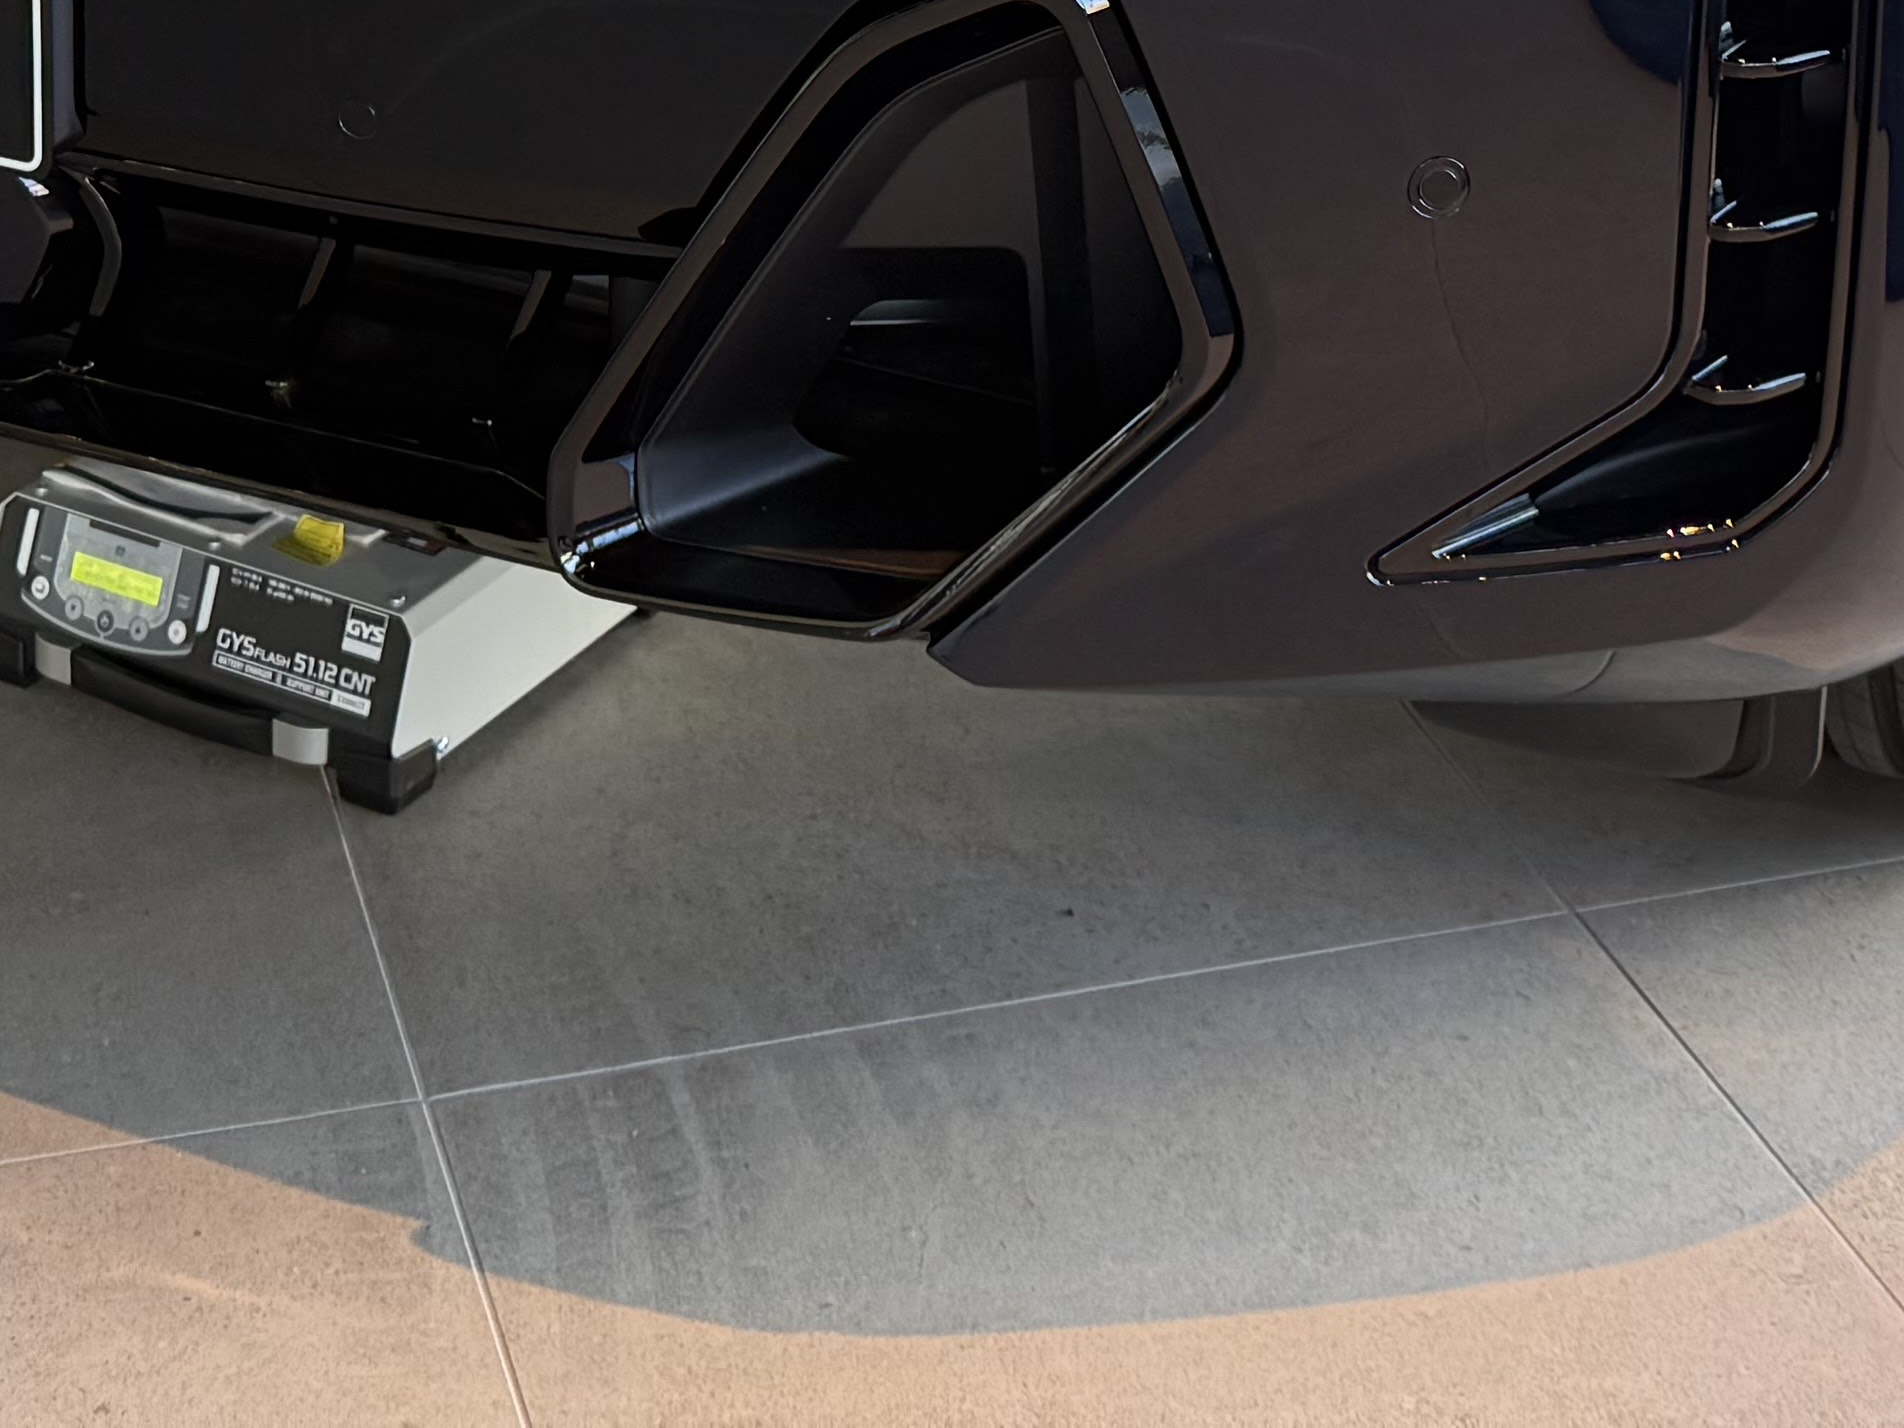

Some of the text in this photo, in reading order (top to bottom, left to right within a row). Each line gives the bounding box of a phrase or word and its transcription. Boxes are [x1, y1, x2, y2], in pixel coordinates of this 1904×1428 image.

[346, 618, 386, 644] GYS
[293, 652, 339, 685] 51.12
[339, 667, 376, 695] CNT
